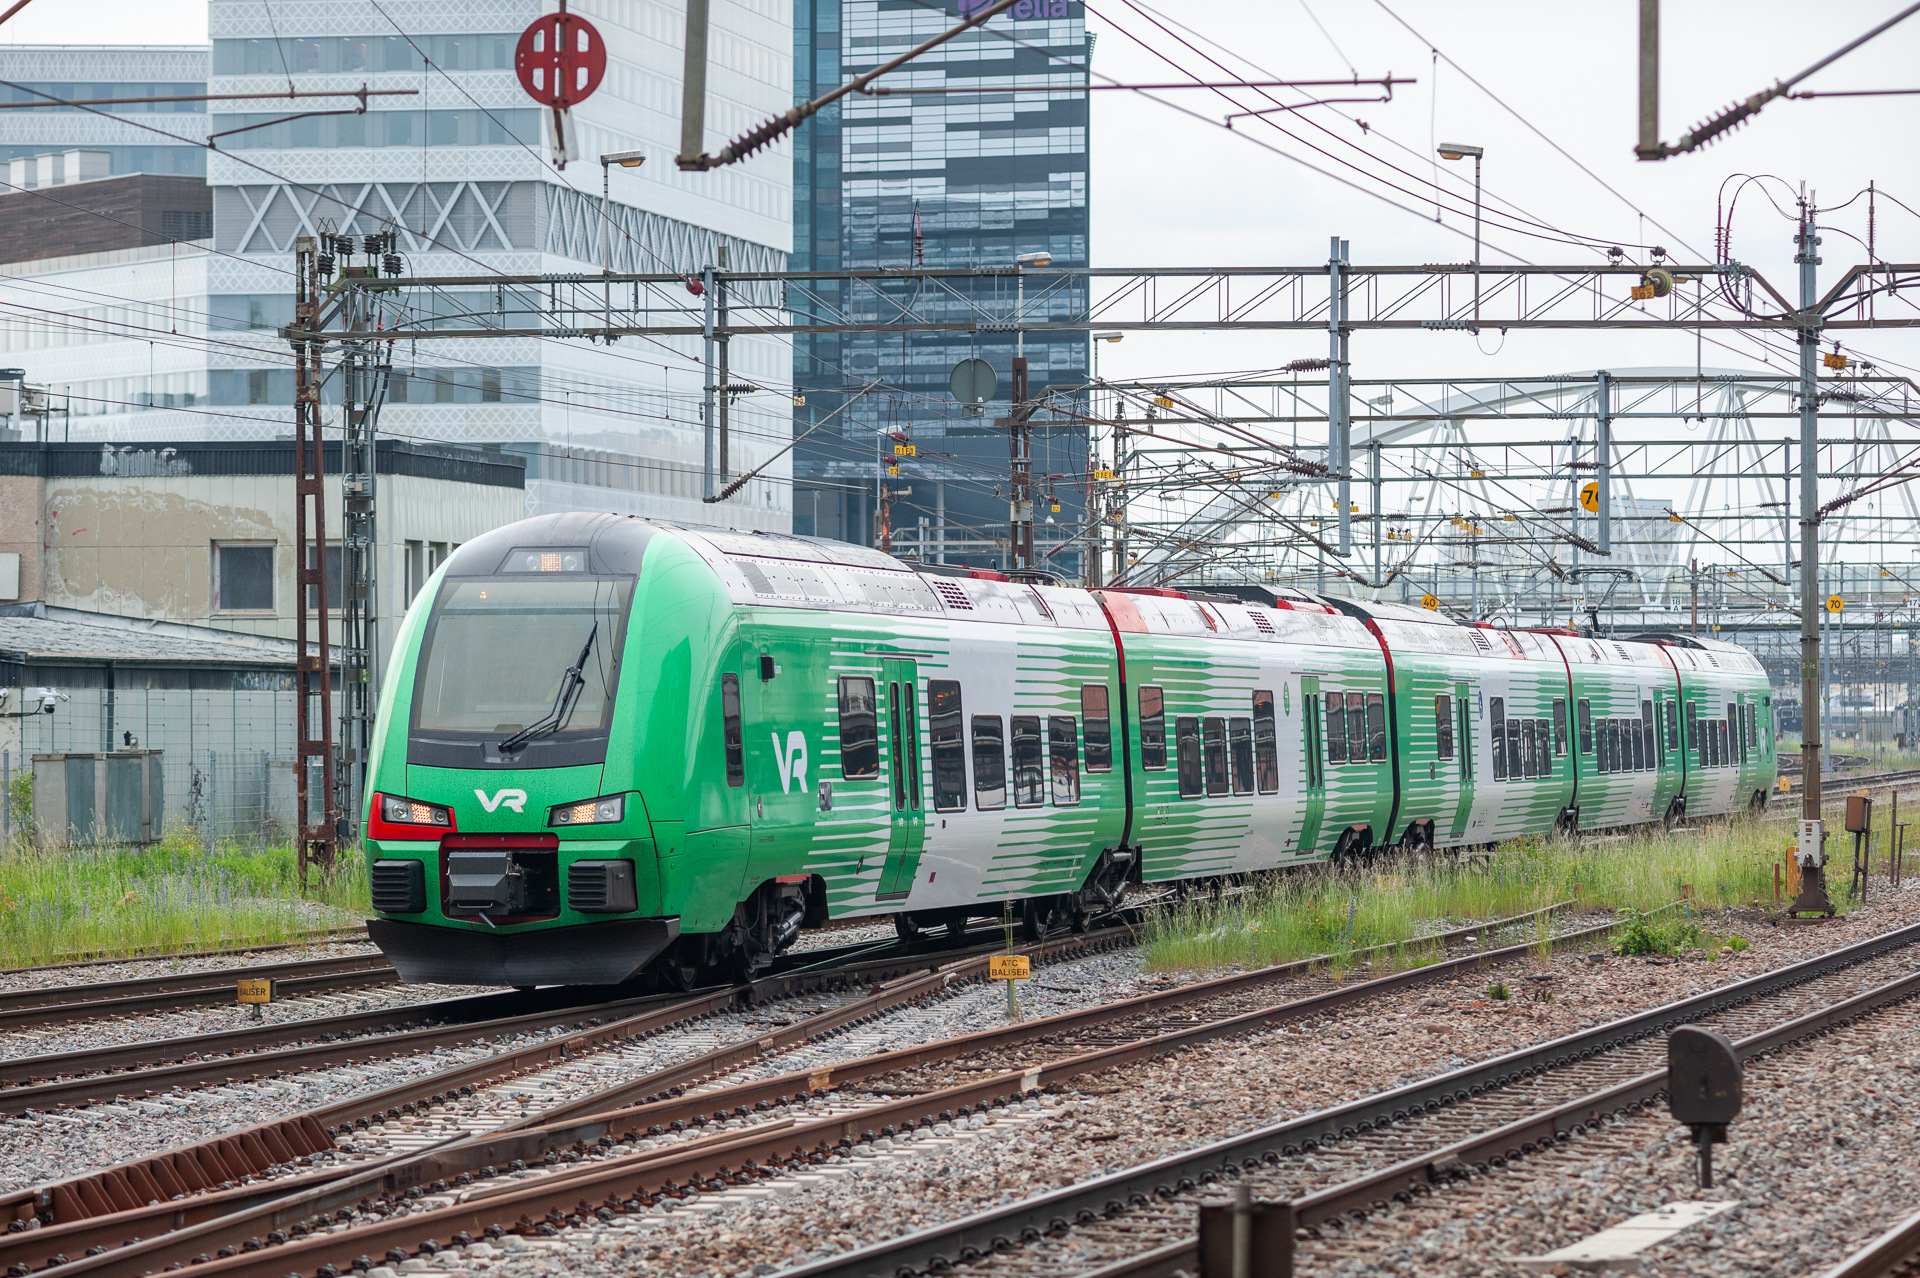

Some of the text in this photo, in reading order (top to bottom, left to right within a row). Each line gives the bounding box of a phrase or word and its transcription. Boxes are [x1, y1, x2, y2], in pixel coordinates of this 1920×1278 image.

[1583, 490, 1598, 504] 7
[1424, 598, 1435, 607] 40
[1830, 600, 1841, 608] 70
[771, 731, 809, 795] VR
[473, 788, 528, 813] VR
[1001, 959, 1019, 967] ATC
[991, 968, 1029, 976] BALISER
